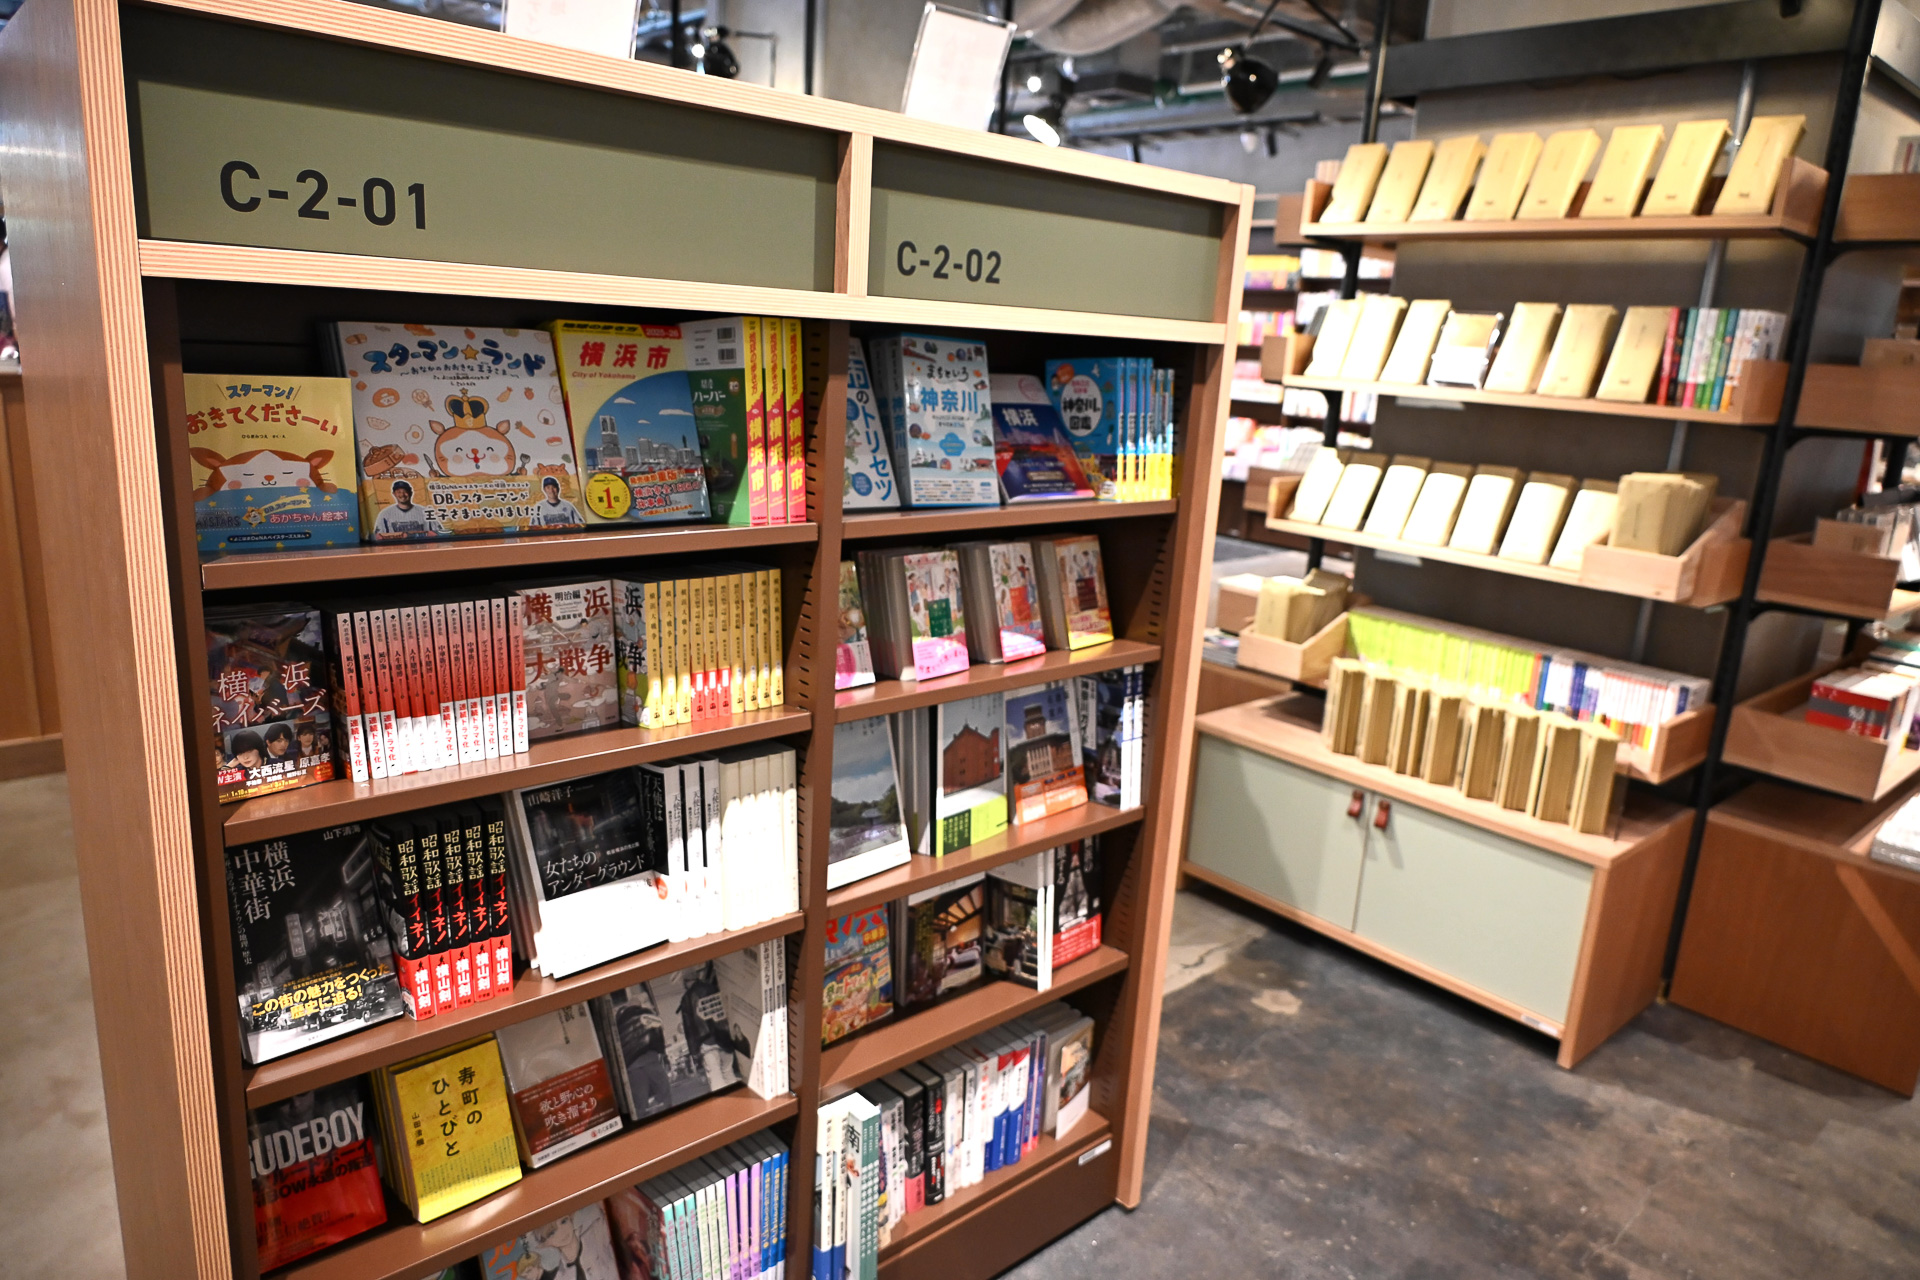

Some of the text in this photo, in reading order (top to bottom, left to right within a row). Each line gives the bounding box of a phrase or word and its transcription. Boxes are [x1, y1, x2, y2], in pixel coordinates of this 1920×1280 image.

[219, 161, 427, 230] C-2-01
[897, 240, 1001, 284] C-2-02
[363, 338, 546, 378] スターマン ランド
[580, 341, 671, 369] 横浜市
[226, 384, 295, 400] スターマン!
[920, 386, 979, 414] 神奈川
[186, 403, 338, 435] おきてくださーい
[1002, 408, 1039, 427] 横浜
[270, 512, 348, 524] あかちゃん絵本!
[424, 505, 541, 521] 王子さまになりました!
[433, 492, 528, 505] DB.スターマンが
[196, 516, 241, 529] AYSTARS
[554, 589, 582, 602] 明治編
[525, 643, 615, 685] 大戦争
[212, 687, 328, 734] ネイバーズ
[443, 705, 454, 751] 連続ドラマ化
[459, 703, 469, 748] 連続ドラマ化
[470, 701, 480, 746] 連続ドラマ化
[486, 699, 496, 744] 連続ドラマ化
[500, 696, 510, 741] 連続ドラマ化
[516, 694, 525, 738] 連続ドラマ化
[350, 719, 363, 766] 連続ドラマ化
[368, 716, 382, 763] 連続ドラマ化
[383, 714, 396, 761] 連続ドラマ化
[249, 760, 295, 780] 大西流星
[528, 785, 574, 807] 山崎洋子
[262, 841, 296, 893] 横浜
[444, 829, 468, 941] 昭和歌謡イイネ!
[466, 824, 488, 936] 昭和歌謡イイネ!
[488, 820, 508, 930] 昭和歌謡イイネ!
[543, 851, 597, 879] 女たちの
[547, 853, 645, 896] アンダーグラウンド
[233, 850, 272, 925] 中華街
[397, 839, 426, 953] 昭和歌謡イイネ!
[421, 833, 447, 947] 昭和歌謡イイネ!
[435, 963, 452, 1004] 横山剣
[456, 957, 472, 998] 横山剣
[475, 951, 491, 992] 横山剣
[495, 946, 510, 986] 横山剣
[252, 963, 391, 1017] この街の魅力をつくった
[290, 984, 364, 1020] 歴史に迫る!
[414, 968, 432, 1010] 横山剣
[458, 1066, 482, 1125] 寿町の
[540, 1084, 594, 1115] 欲と野心の
[545, 1097, 598, 1131] 吹き溜まり
[432, 1077, 460, 1157] ひとびと
